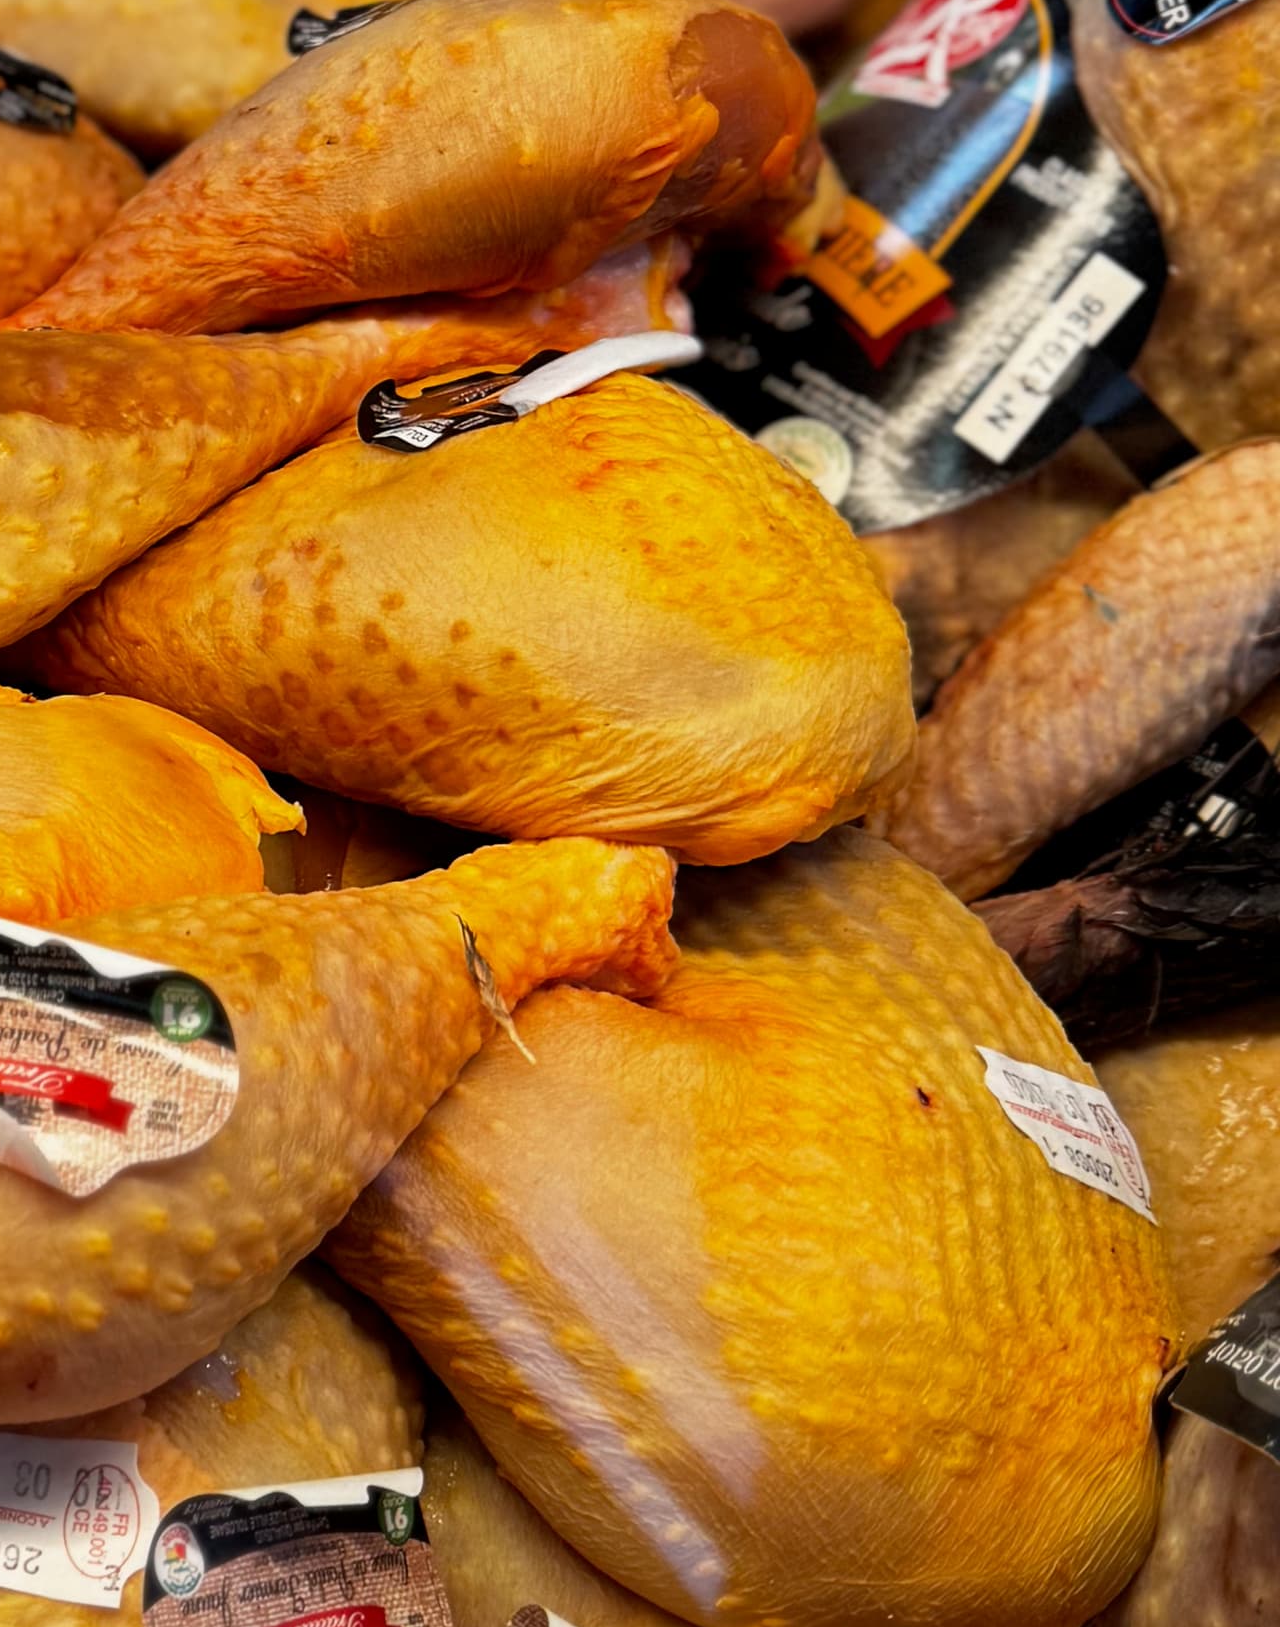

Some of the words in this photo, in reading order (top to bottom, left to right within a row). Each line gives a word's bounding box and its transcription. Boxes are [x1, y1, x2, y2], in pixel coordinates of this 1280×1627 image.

[159, 1000, 203, 1030] 91
[12, 1459, 50, 1500] 03
[383, 1506, 409, 1531] 91
